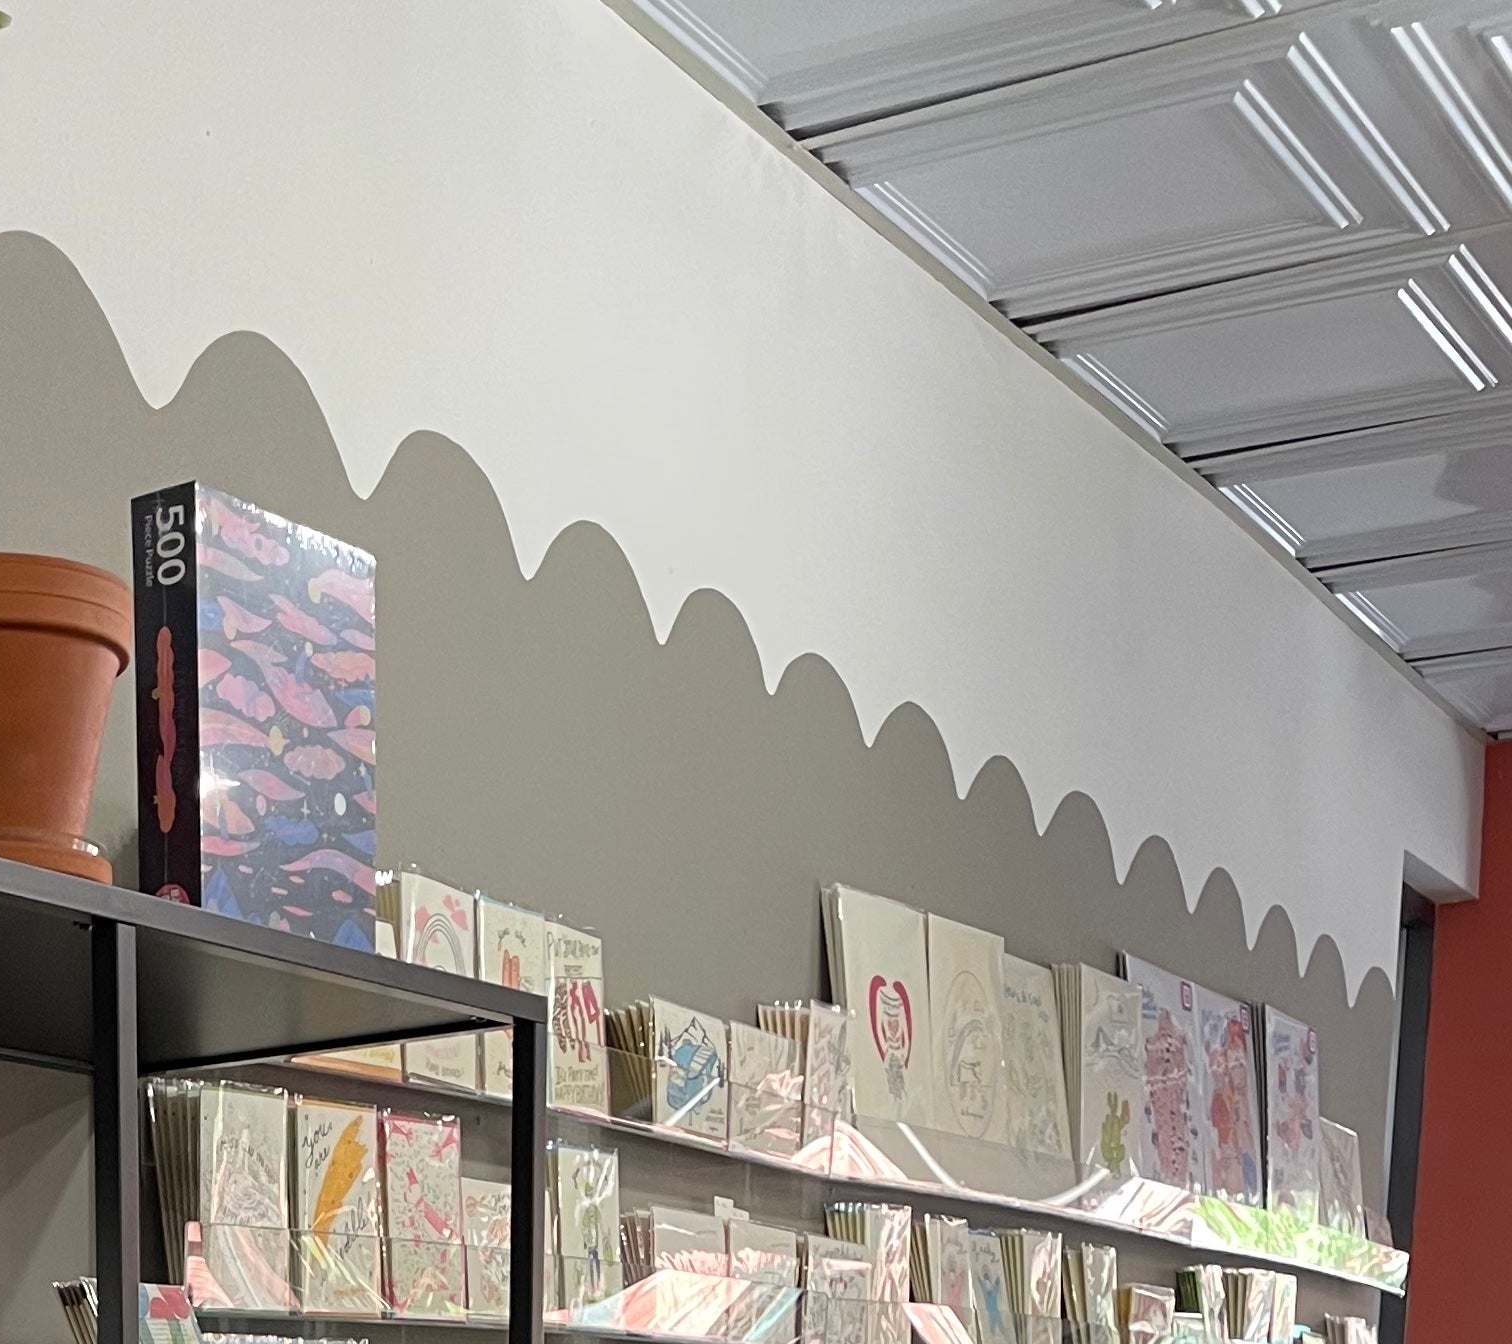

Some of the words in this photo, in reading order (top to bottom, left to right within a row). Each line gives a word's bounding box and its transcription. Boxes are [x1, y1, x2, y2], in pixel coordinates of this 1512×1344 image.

[144, 514, 153, 548] Piece
[155, 504, 186, 587] 500
[144, 548, 155, 588] Puzzle
